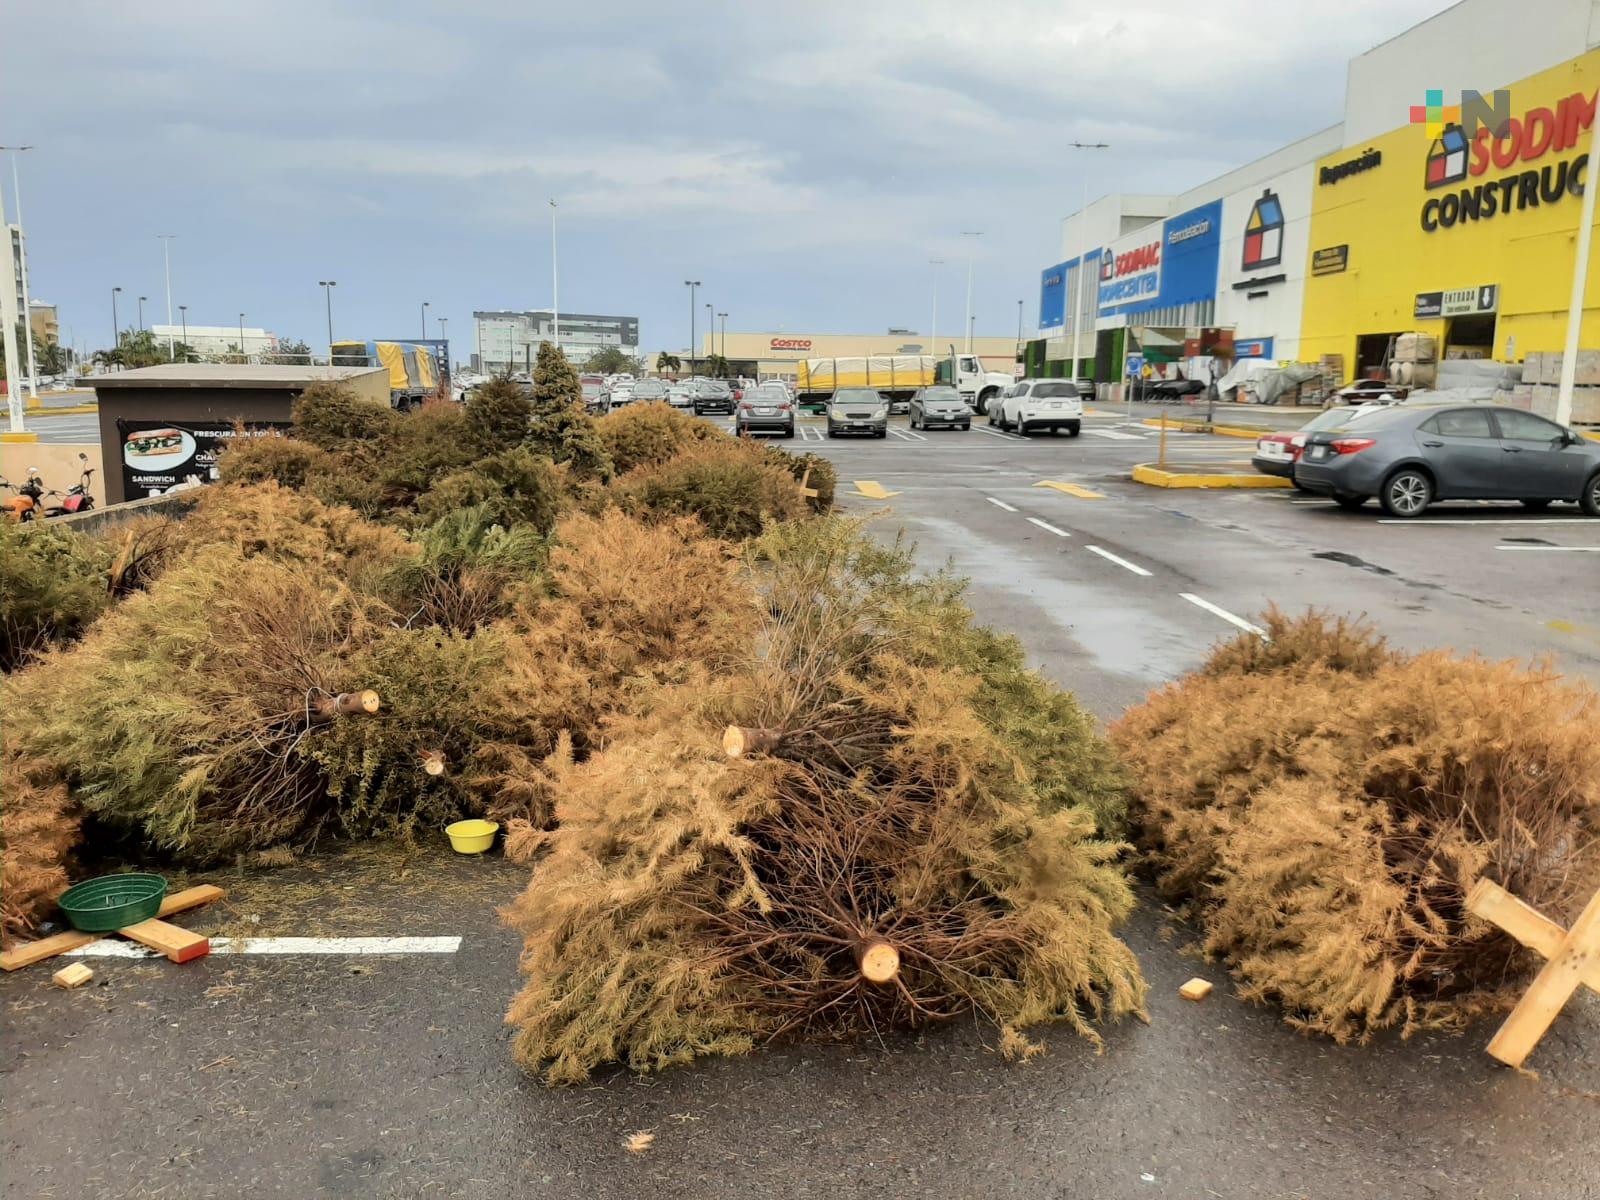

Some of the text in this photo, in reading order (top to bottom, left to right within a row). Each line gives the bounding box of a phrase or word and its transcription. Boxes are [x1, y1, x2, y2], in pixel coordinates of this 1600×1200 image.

[1114, 241, 1160, 278] SODIMAC
[1445, 290, 1475, 304] ENTRADA
[193, 430, 236, 438] FRESCURA
[132, 475, 175, 483] SANDWICH
